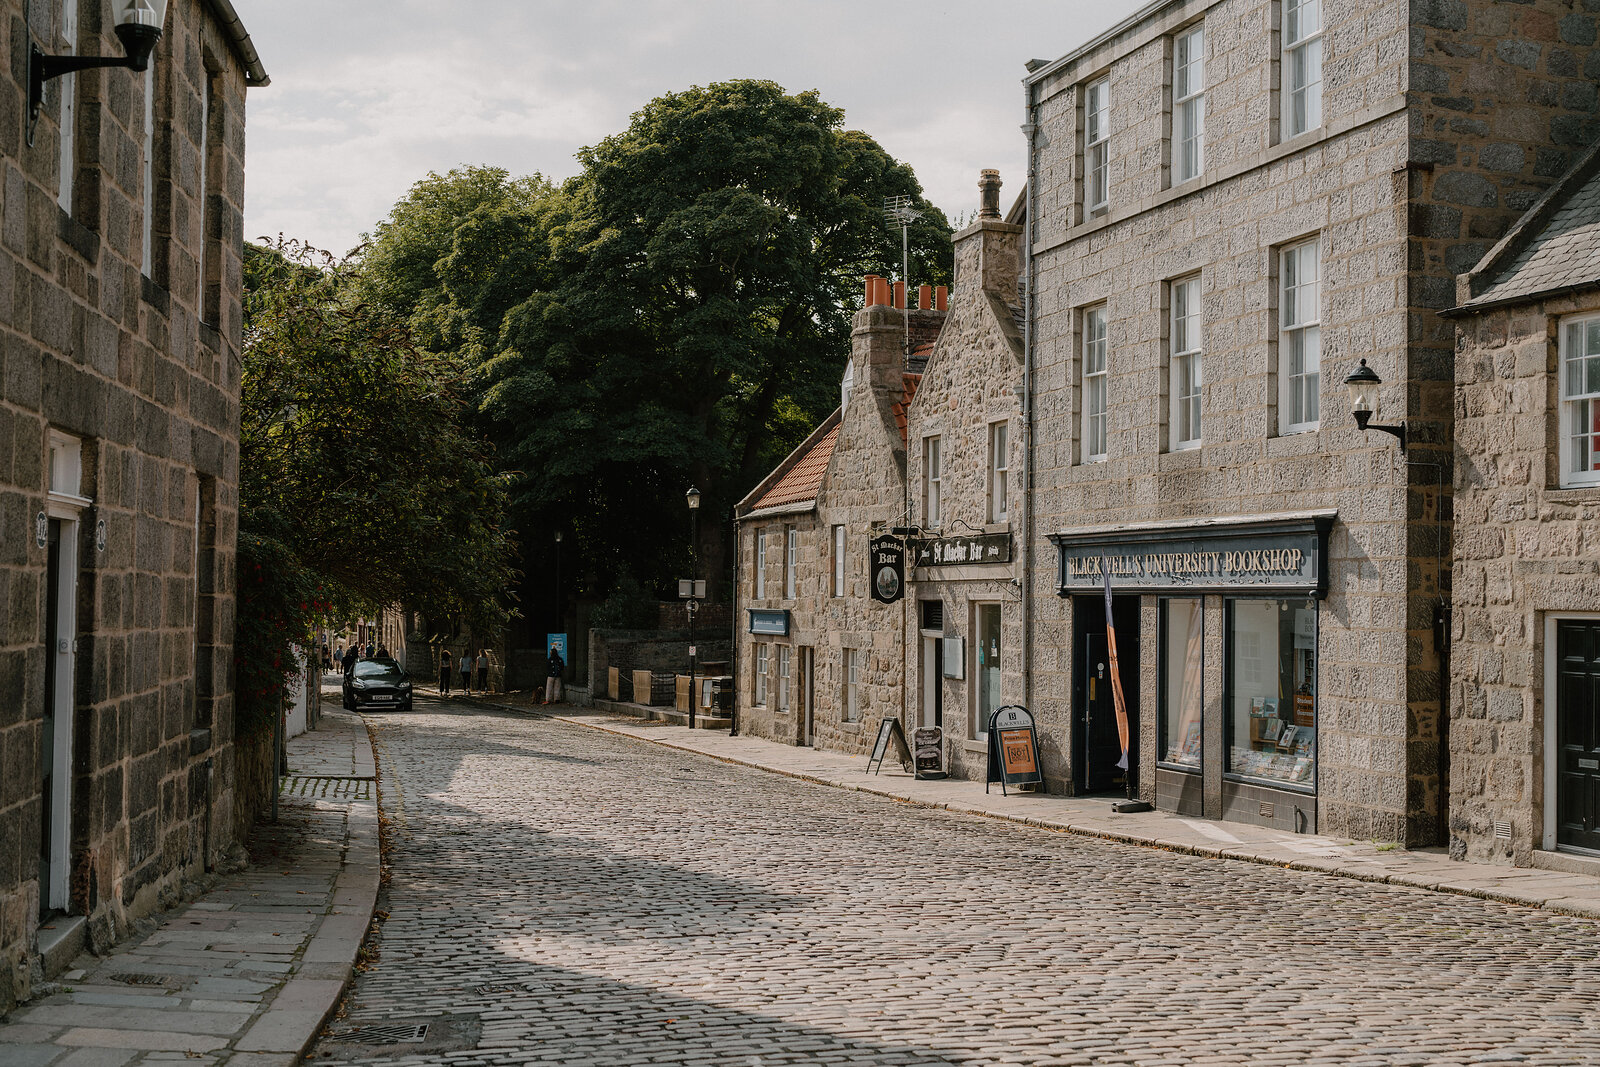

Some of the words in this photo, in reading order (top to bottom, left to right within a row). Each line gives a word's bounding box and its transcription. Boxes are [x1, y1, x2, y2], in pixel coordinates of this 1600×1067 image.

[871, 543, 879, 553] St
[878, 552, 897, 564] Bar
[1145, 551, 1221, 573] UNIVERSITY
[1225, 548, 1302, 572] BOOKSHOP
[1011, 748, 1025, 758] NOT
